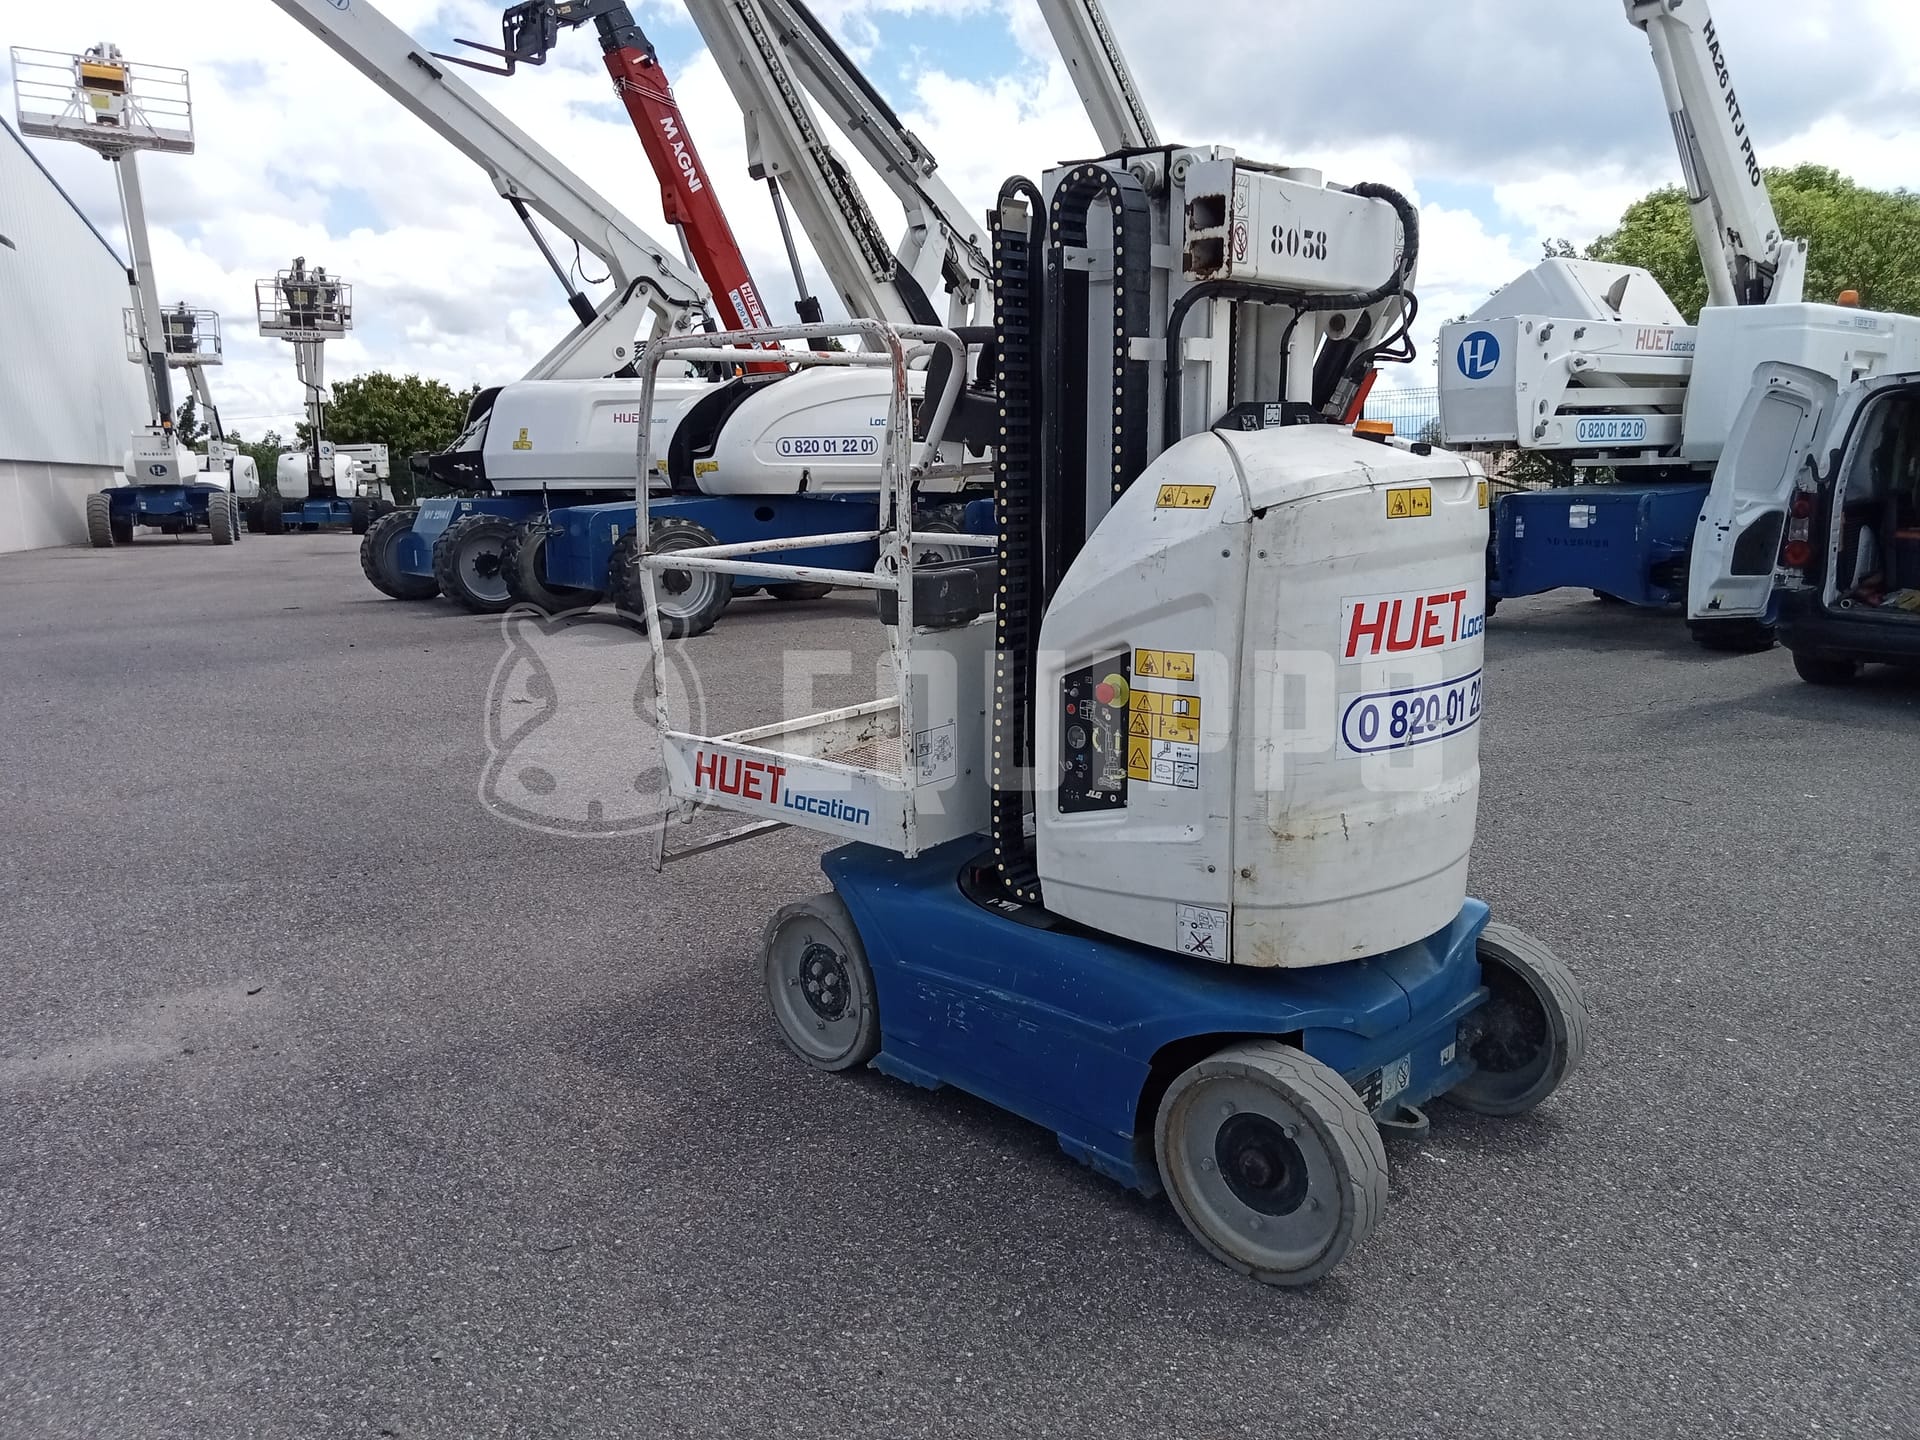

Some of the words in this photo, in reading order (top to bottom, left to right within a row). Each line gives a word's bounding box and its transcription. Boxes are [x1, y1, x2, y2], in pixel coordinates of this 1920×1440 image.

[1703, 19, 1730, 89] HA26
[1725, 88, 1745, 137] RTJ
[1740, 136, 1761, 188] PRO
[660, 116, 703, 193] MAGNI
[742, 286, 762, 317] HUET
[1635, 329, 1674, 351] HUET
[782, 440, 791, 453] 0
[794, 440, 820, 453] 820
[823, 440, 838, 453] 01
[842, 439, 858, 452] 22
[861, 439, 874, 452] 01
[1580, 422, 1586, 438] 0
[1588, 422, 1606, 438] 820
[1607, 422, 1618, 438] 01
[1621, 421, 1632, 437] 22
[1634, 421, 1643, 437] 01
[1345, 590, 1467, 658] HUET
[1358, 704, 1380, 743] 0
[1389, 694, 1441, 739] 820
[1446, 686, 1466, 726] 01
[695, 751, 787, 804] HUET
[784, 787, 871, 826] Location
